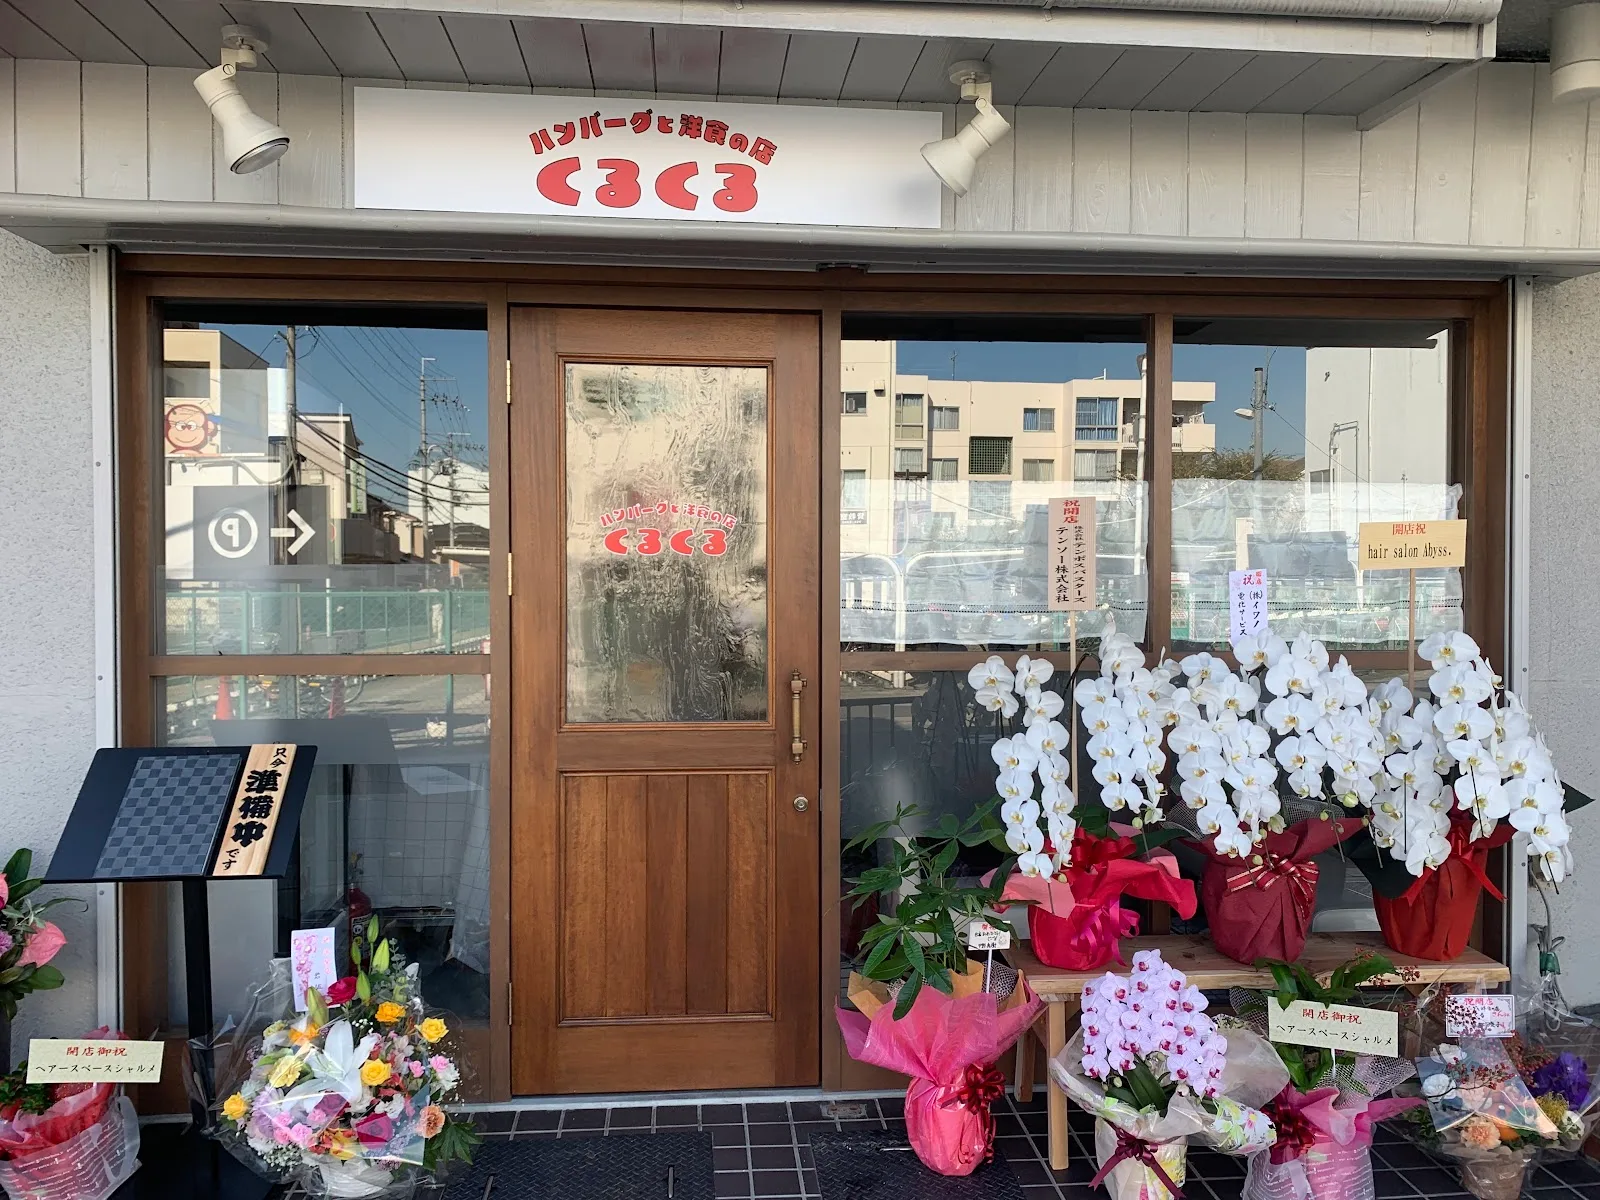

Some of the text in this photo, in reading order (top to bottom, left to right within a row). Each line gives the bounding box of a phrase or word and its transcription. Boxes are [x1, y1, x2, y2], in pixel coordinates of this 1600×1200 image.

[528, 108, 778, 166] ハンバーグと洋食の店
[536, 156, 759, 213] くるくる
[600, 500, 737, 530] ハンバーグと洋食の店
[1062, 499, 1080, 524] 祝開店
[604, 527, 728, 556] くるくる
[1392, 523, 1427, 536] 開店祝
[1368, 542, 1451, 559] hair salon Abyss.
[1055, 526, 1070, 603] テンソー株式会社
[1242, 574, 1255, 586] 祝
[230, 769, 282, 848] 準備中
[1302, 1008, 1362, 1025] 開店御祝
[66, 1046, 128, 1057] 開店御祝
